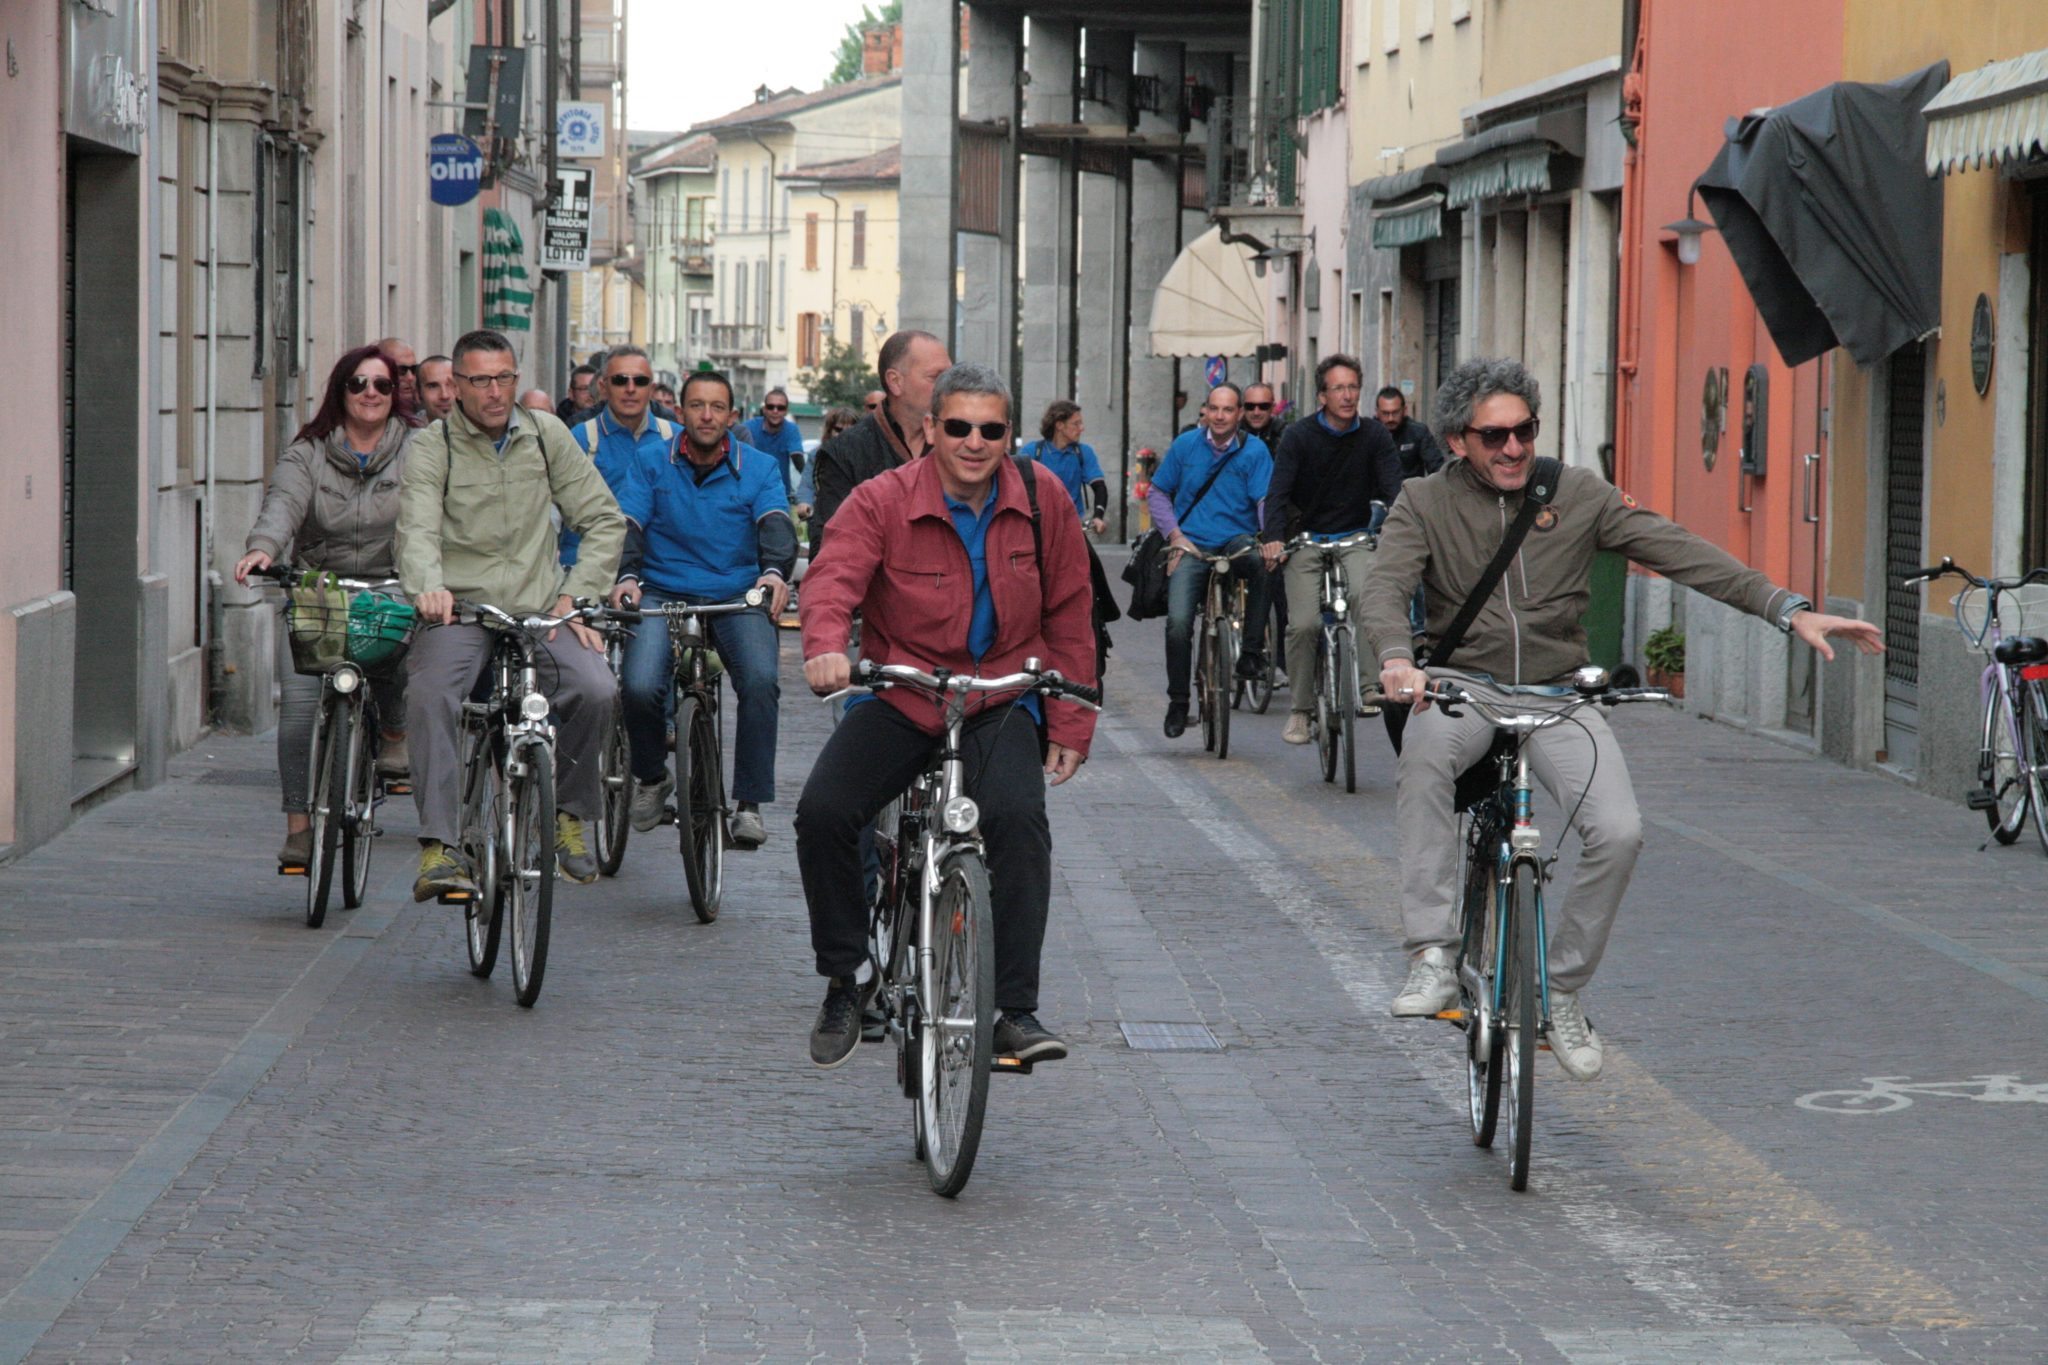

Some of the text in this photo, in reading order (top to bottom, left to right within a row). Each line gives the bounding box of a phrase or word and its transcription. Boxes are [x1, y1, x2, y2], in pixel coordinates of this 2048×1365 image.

[431, 157, 482, 181] oint
[556, 170, 586, 210] T
[547, 217, 588, 228] TABACCHI
[552, 231, 580, 239] VALORI
[550, 239, 582, 247] BOLLATI
[546, 248, 584, 261] LOTTO
